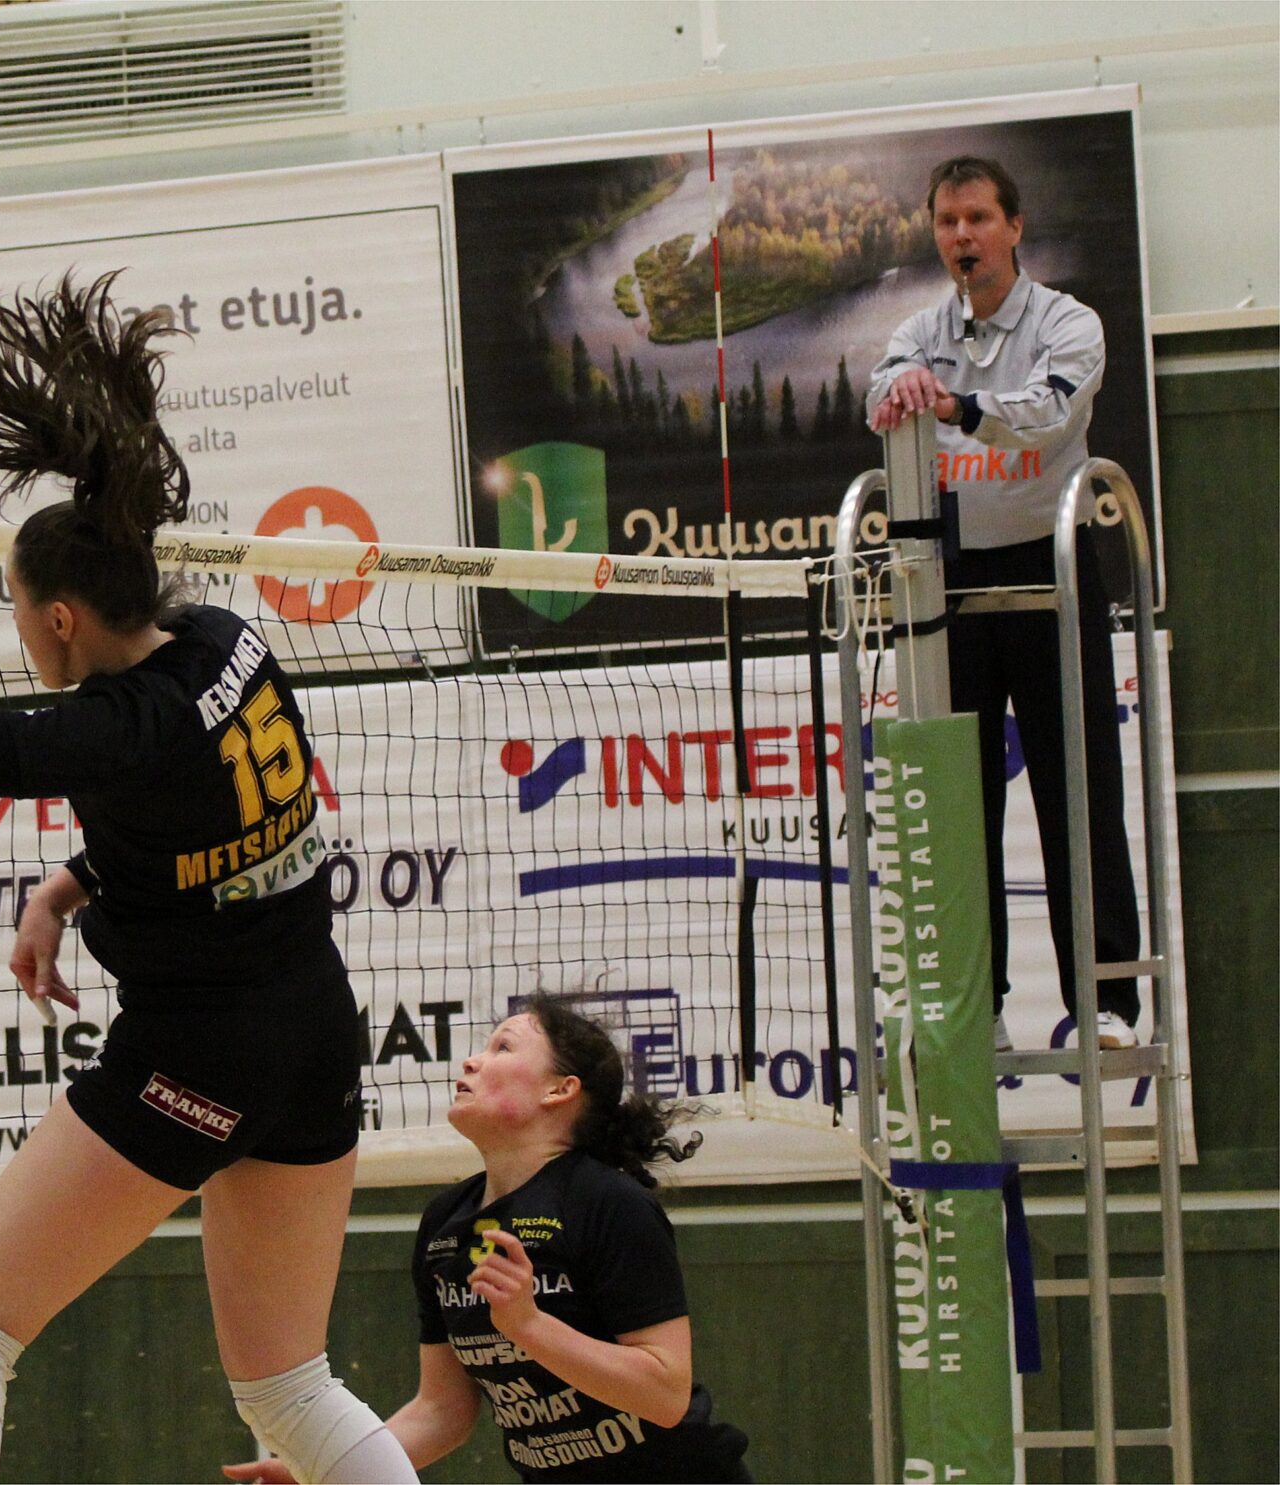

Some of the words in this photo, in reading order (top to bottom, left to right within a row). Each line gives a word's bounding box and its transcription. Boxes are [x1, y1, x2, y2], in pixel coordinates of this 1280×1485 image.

[220, 275, 363, 336] etuja.
[188, 426, 237, 454] alta
[373, 553, 429, 573] Kuusamon
[431, 554, 496, 580] Osuuspankki
[610, 563, 659, 583] Kuusamon
[661, 564, 715, 589] Osuuspankki
[219, 679, 307, 831] 15
[380, 847, 458, 906] OY
[901, 762, 945, 1023] HIRSITALOT
[147, 1080, 235, 1133] FRANKE
[518, 1229, 554, 1241] VOLLEY
[930, 1114, 962, 1374] HIRSITAOT
[595, 1411, 646, 1454] OY
